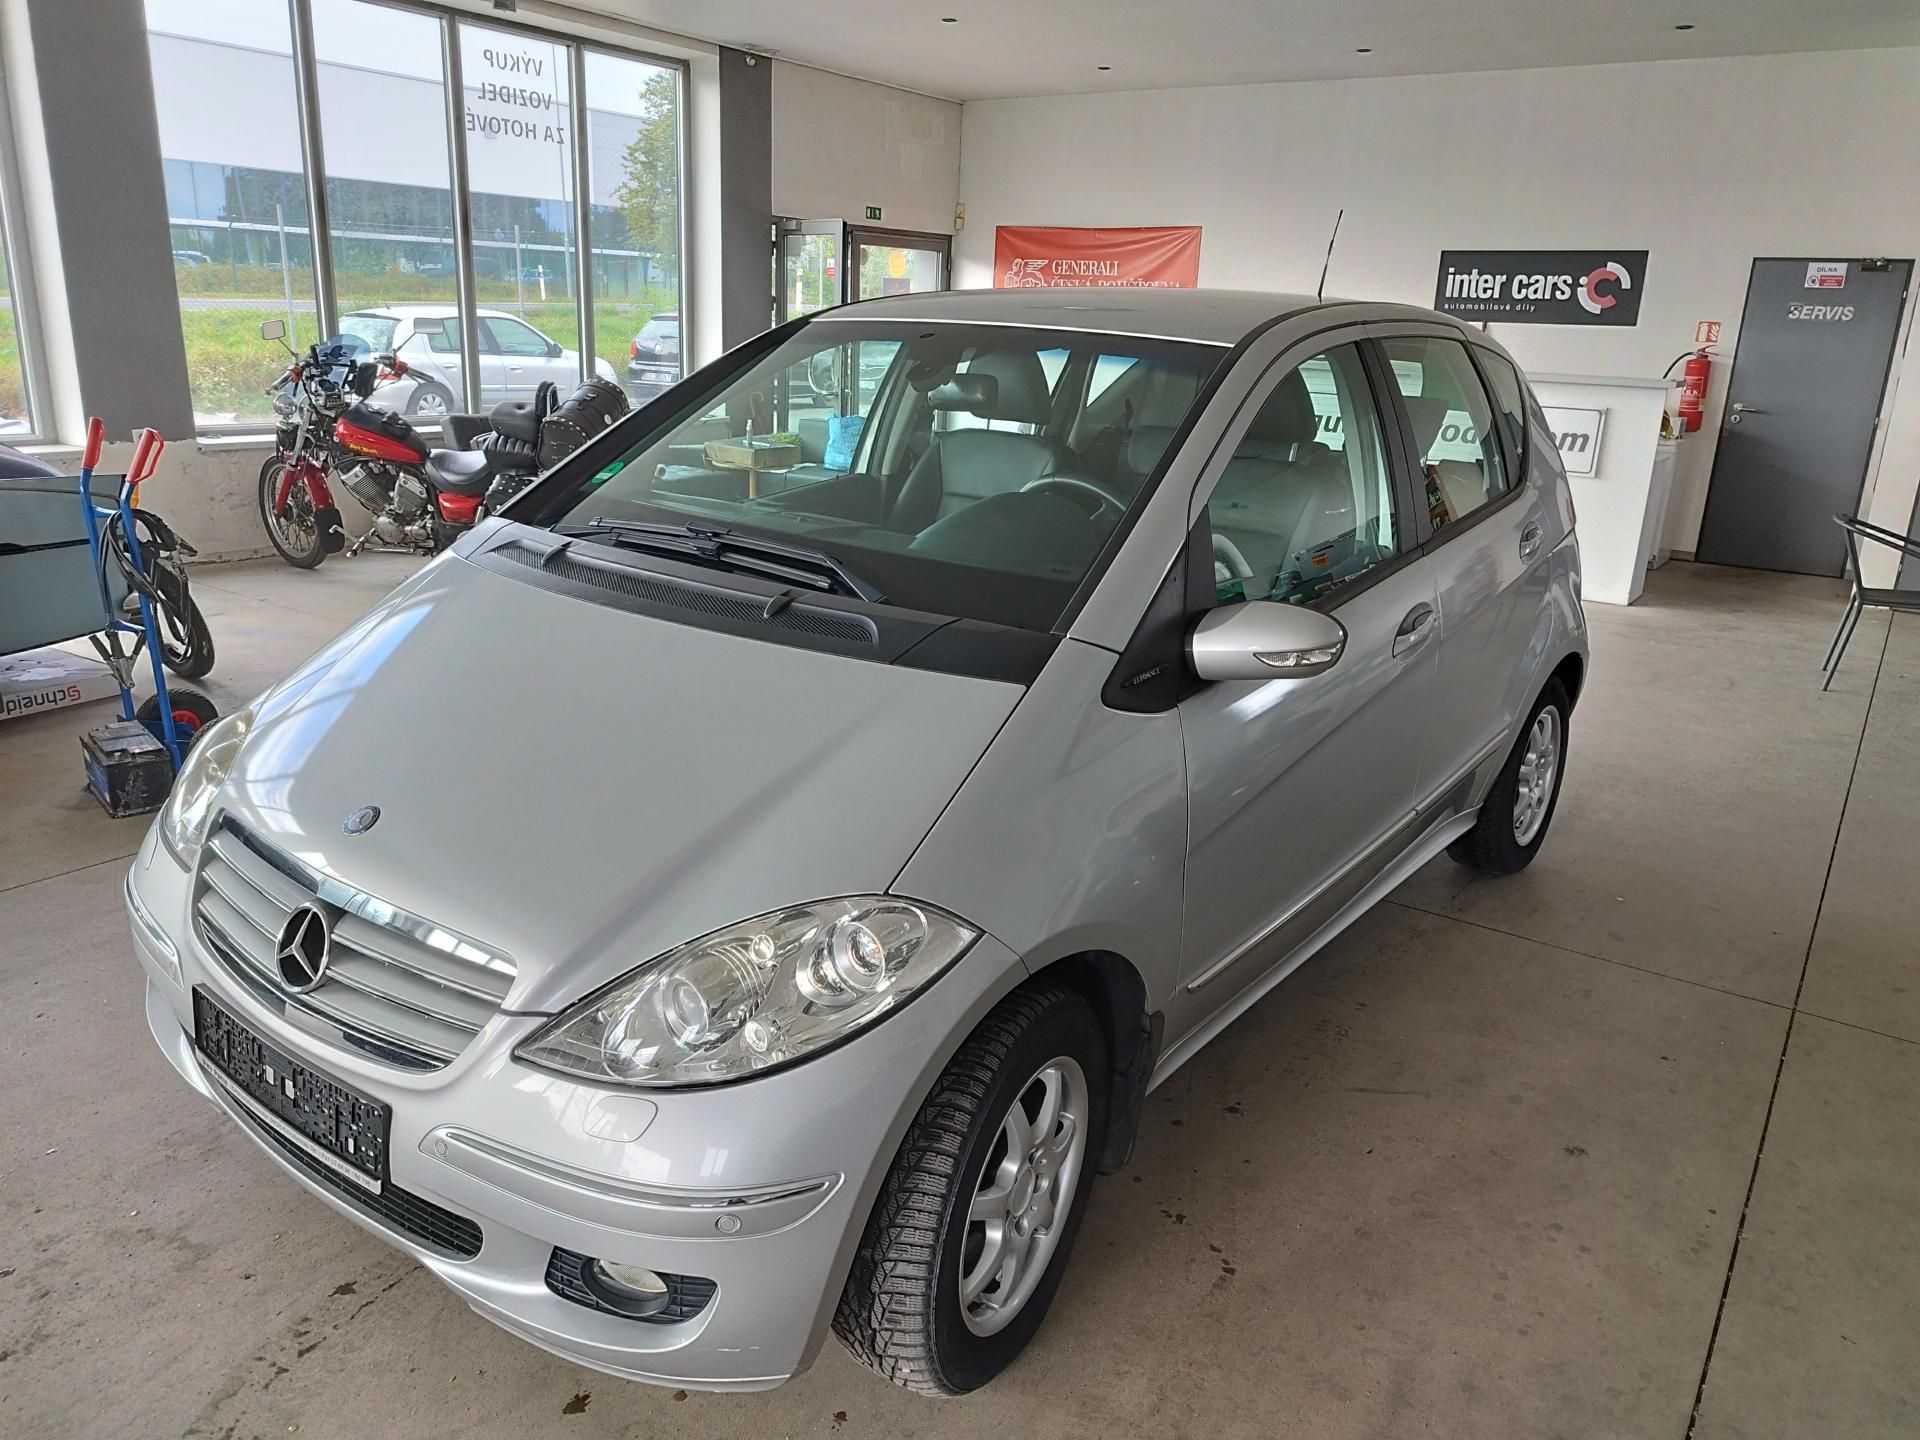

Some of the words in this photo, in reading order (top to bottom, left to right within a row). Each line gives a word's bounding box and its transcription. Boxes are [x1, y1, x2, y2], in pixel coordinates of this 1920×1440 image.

[1052, 260, 1119, 276] GENERALI
[1445, 267, 1507, 299] inter
[1511, 274, 1573, 301] cars
[1788, 303, 1855, 321] SERVIS
